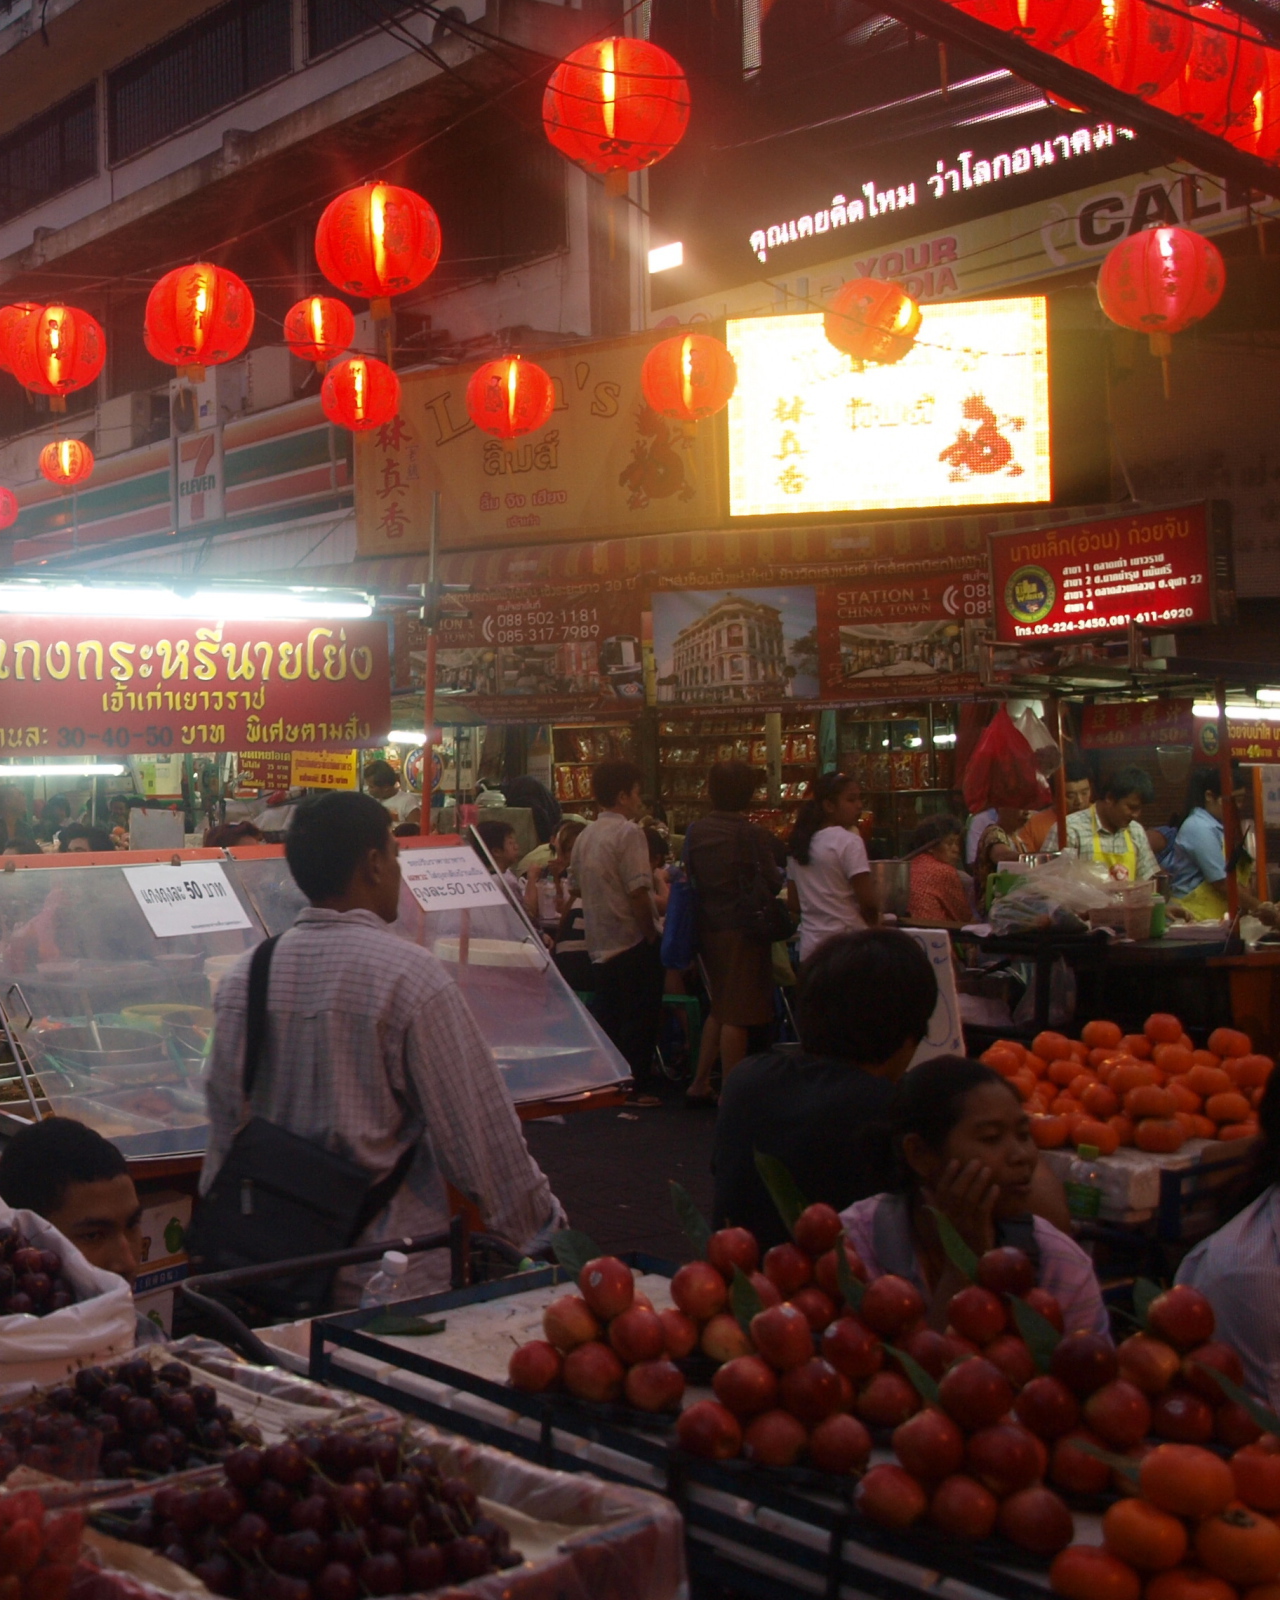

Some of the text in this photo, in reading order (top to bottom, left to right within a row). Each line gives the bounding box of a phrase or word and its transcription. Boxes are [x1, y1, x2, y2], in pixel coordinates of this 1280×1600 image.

[853, 236, 958, 279] YOUR
[1084, 563, 1090, 573] 1
[1085, 576, 1092, 586] 2
[1086, 588, 1093, 599] 3
[1189, 574, 1203, 584] 22
[837, 587, 930, 606] STATION 1
[837, 602, 931, 619] CHINA TOWN
[1086, 601, 1095, 611] 4
[56, 725, 173, 749] 30-40-50
[180, 723, 226, 744] บาท
[320, 774, 334, 784] 55
[183, 880, 204, 900] 50
